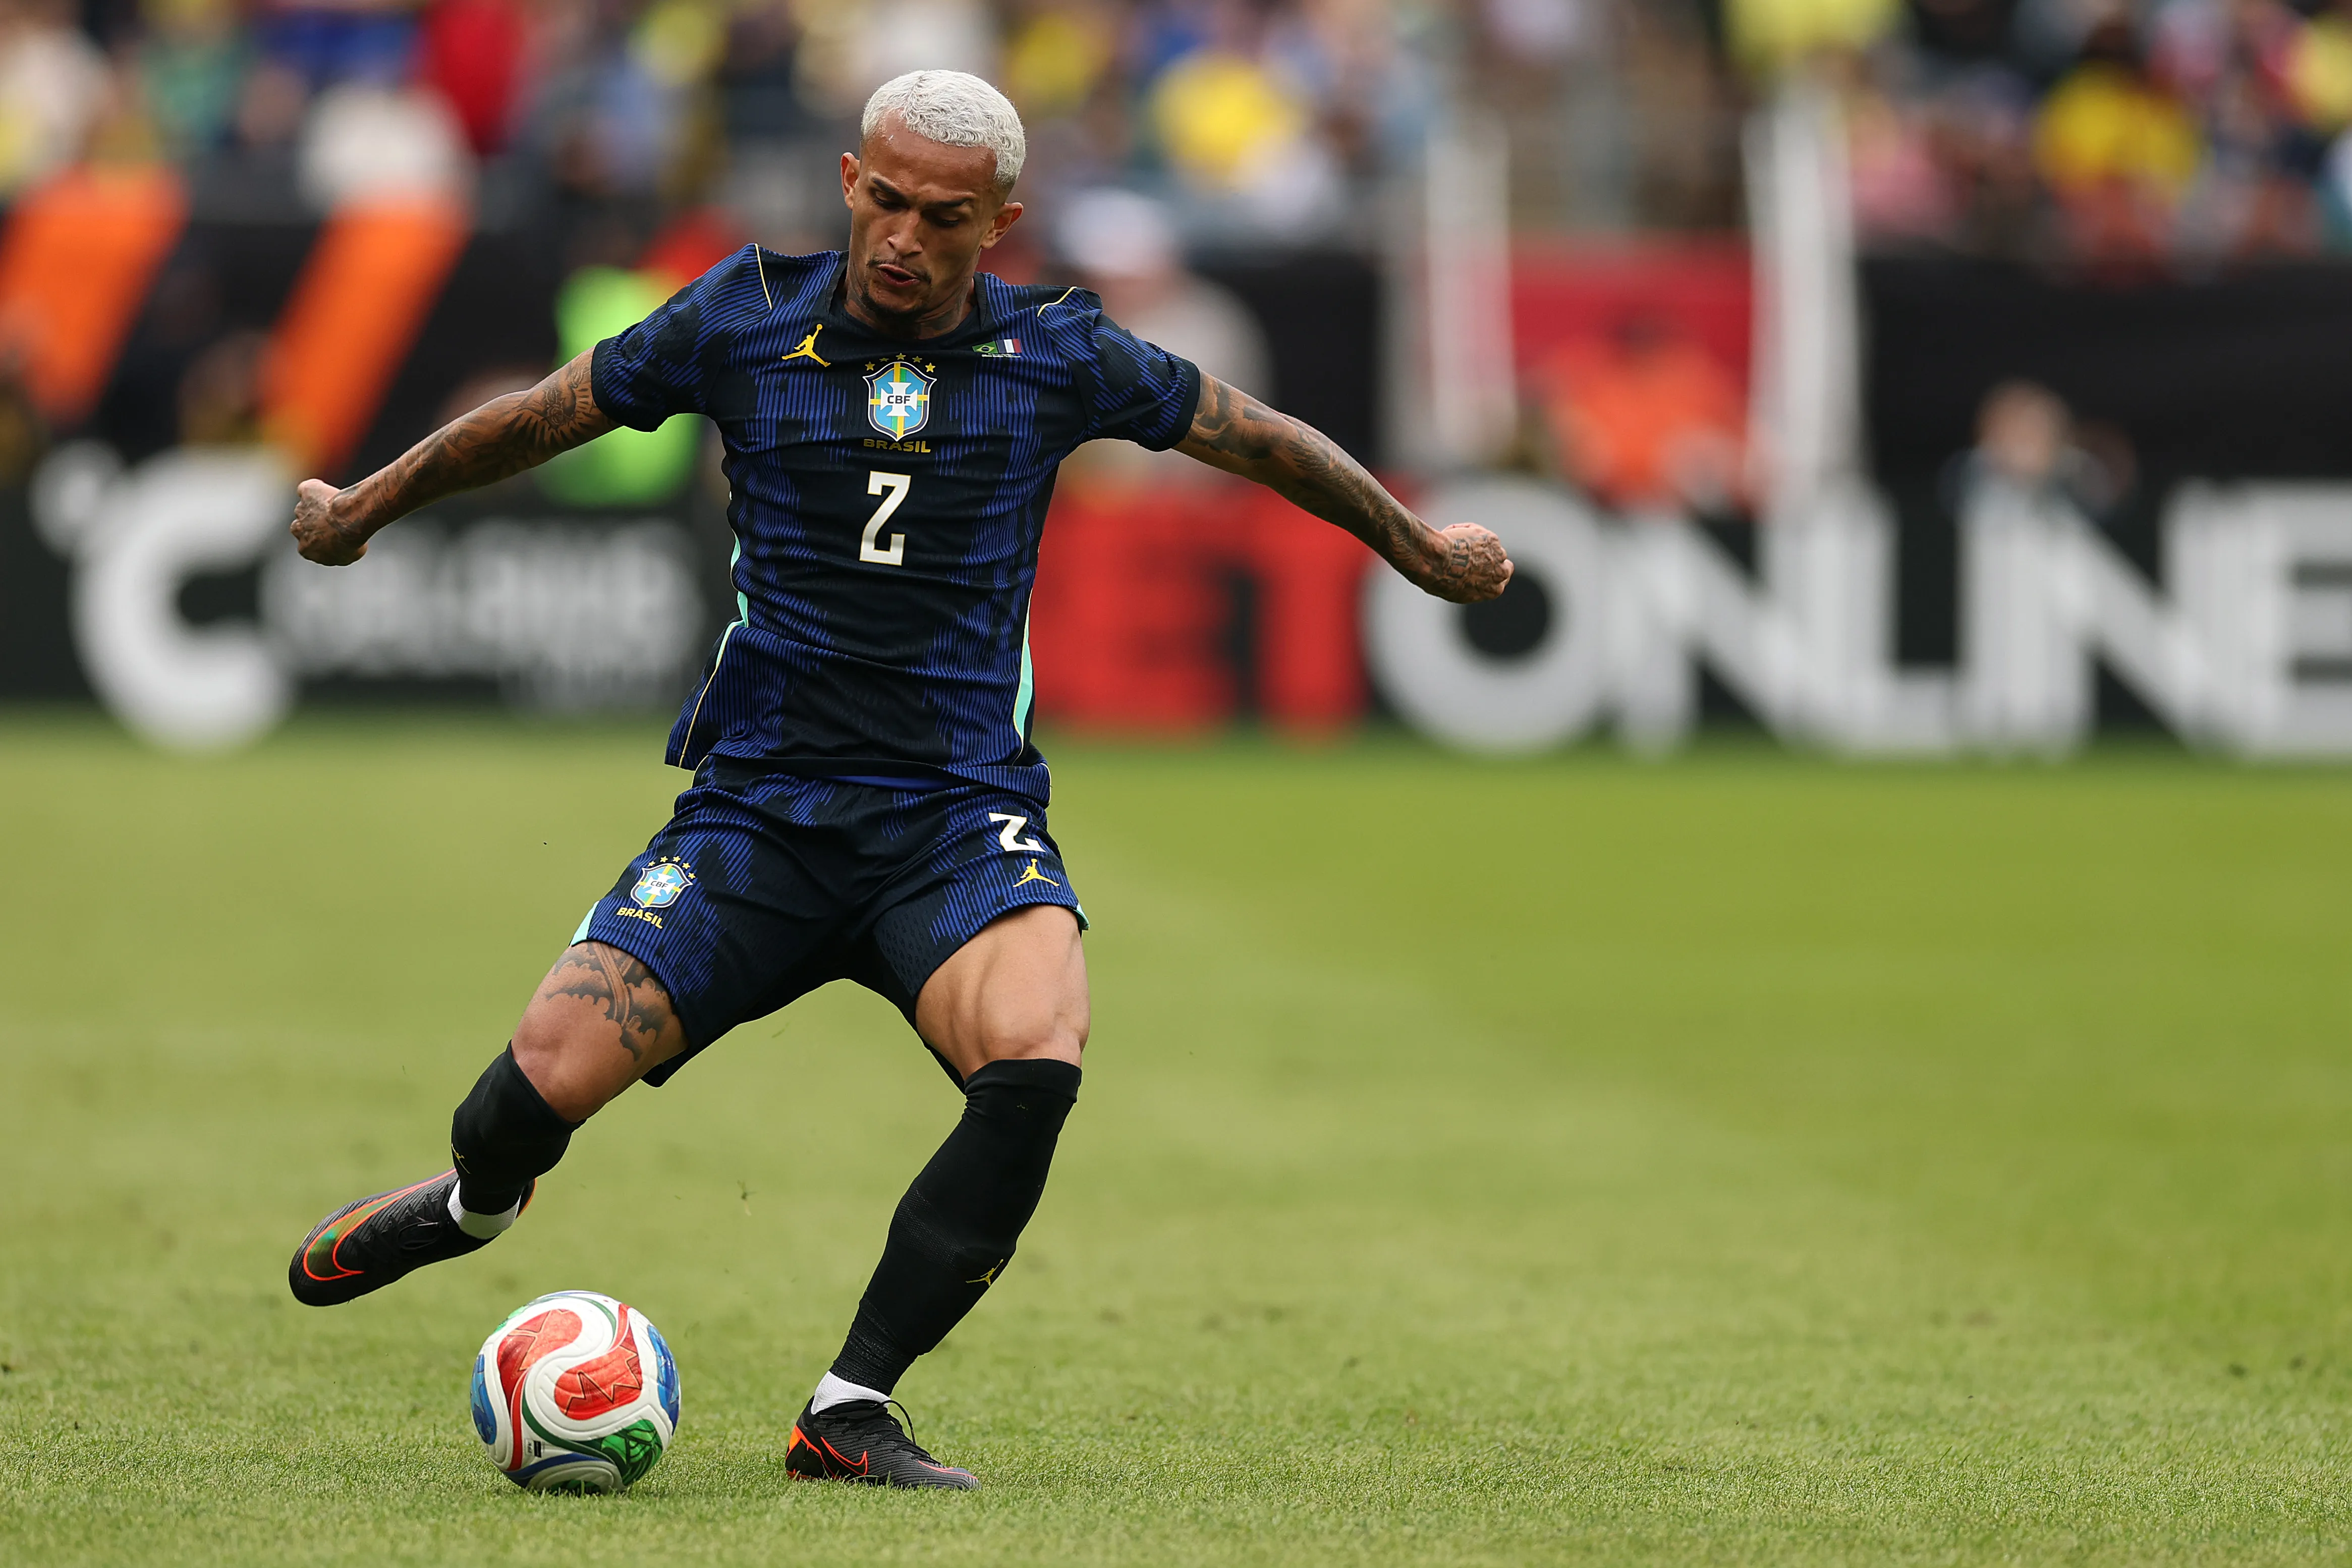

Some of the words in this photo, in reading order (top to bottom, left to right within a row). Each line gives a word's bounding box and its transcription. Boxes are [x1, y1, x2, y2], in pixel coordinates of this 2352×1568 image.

[887, 395, 911, 404] CBF
[863, 438, 931, 453] BRASIL
[859, 470, 911, 566] 2
[988, 812, 1046, 853] 2
[650, 880, 668, 888] CBF
[616, 907, 663, 929] BRASIL
